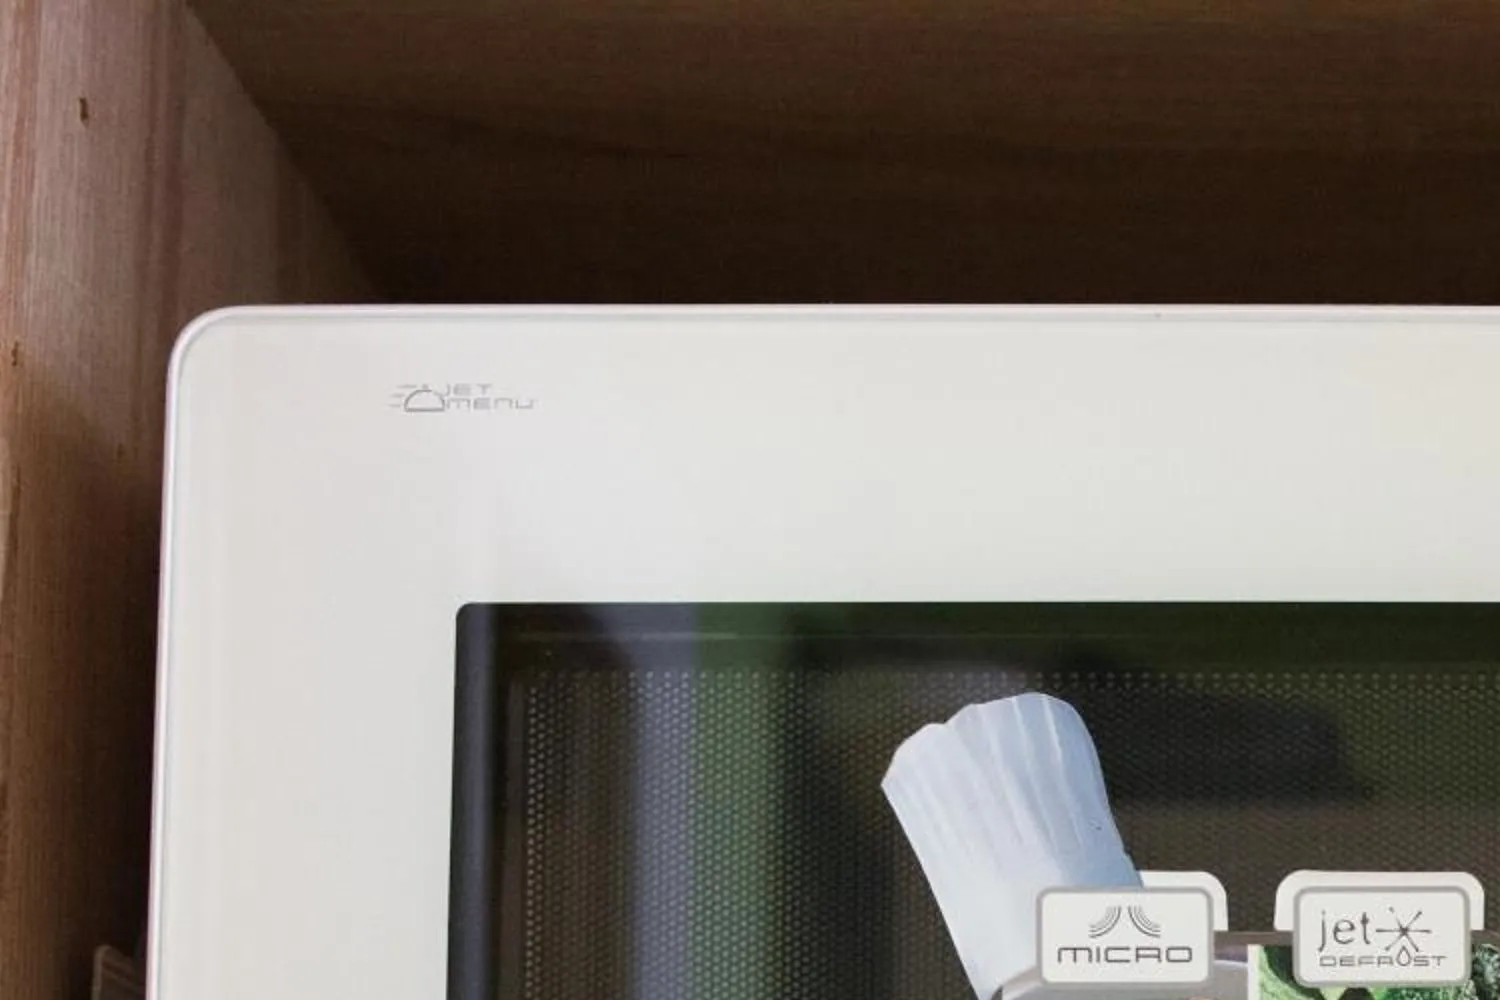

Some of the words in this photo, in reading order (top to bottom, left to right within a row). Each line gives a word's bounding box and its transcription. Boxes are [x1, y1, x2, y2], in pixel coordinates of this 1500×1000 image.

[1317, 909, 1371, 952] jet
[1056, 945, 1194, 964] MICRO
[1319, 945, 1448, 967] DEFROST
